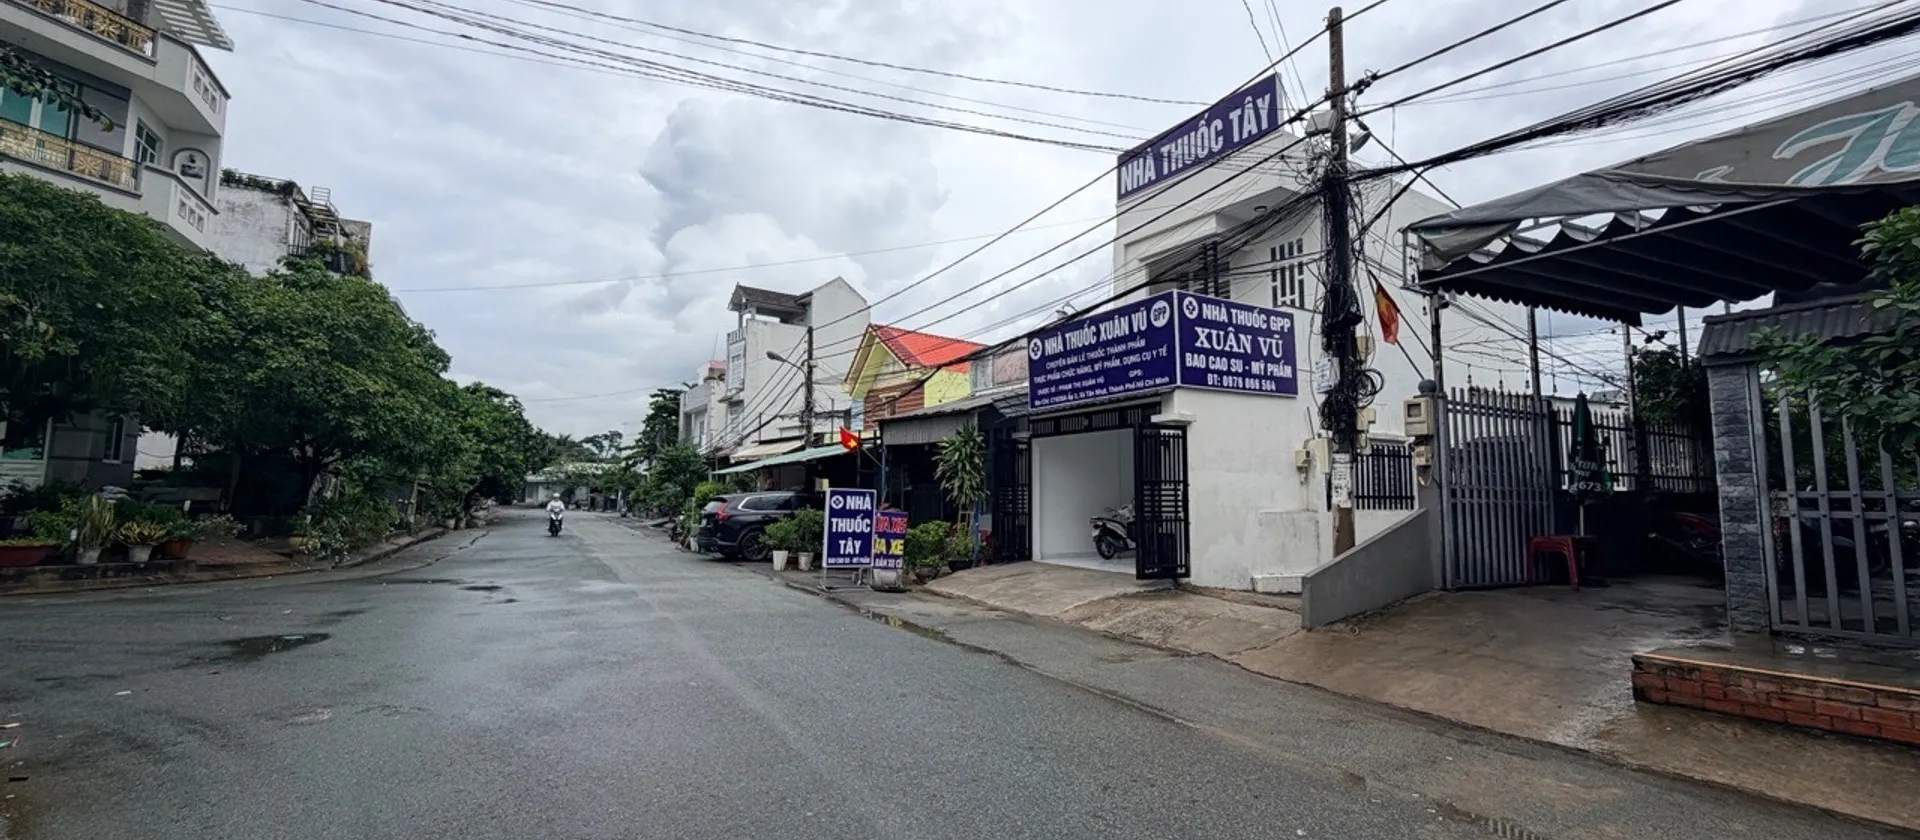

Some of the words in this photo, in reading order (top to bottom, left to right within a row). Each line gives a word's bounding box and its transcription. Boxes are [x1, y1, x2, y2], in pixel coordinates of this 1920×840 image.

[1120, 147, 1156, 194] NHÀ
[1160, 112, 1223, 176] THUỐC
[1229, 93, 1271, 142] TÂY
[1202, 303, 1228, 323] NHÀ
[1230, 308, 1267, 329] THUỐC
[1270, 316, 1291, 332] GPP
[1044, 332, 1064, 356] NHÀ
[1065, 320, 1096, 350] THUỐC
[1099, 315, 1129, 342] XUÂN
[1131, 308, 1147, 332] VŨ
[1194, 326, 1252, 354] XUÂN
[1257, 334, 1283, 358] VŨ
[1046, 356, 1066, 370] CHUYÊN
[1067, 354, 1078, 365] BÁN
[1086, 347, 1106, 360] THUỐC
[1106, 342, 1126, 354] THÀNH
[1122, 354, 1141, 365] DỤNG
[1142, 351, 1151, 361] CỤ
[1158, 344, 1168, 356] TẾ
[1185, 352, 1206, 368] BAO
[1209, 356, 1228, 371] CAO
[1230, 358, 1243, 373] SU
[1251, 360, 1265, 376] MỸ
[1267, 360, 1292, 378] PHẨM
[1207, 374, 1220, 386] ĐT:
[846, 493, 872, 510] NHÀ
[831, 513, 871, 533] THUỐC
[839, 537, 862, 554] TÂY
[889, 539, 904, 555] XE
